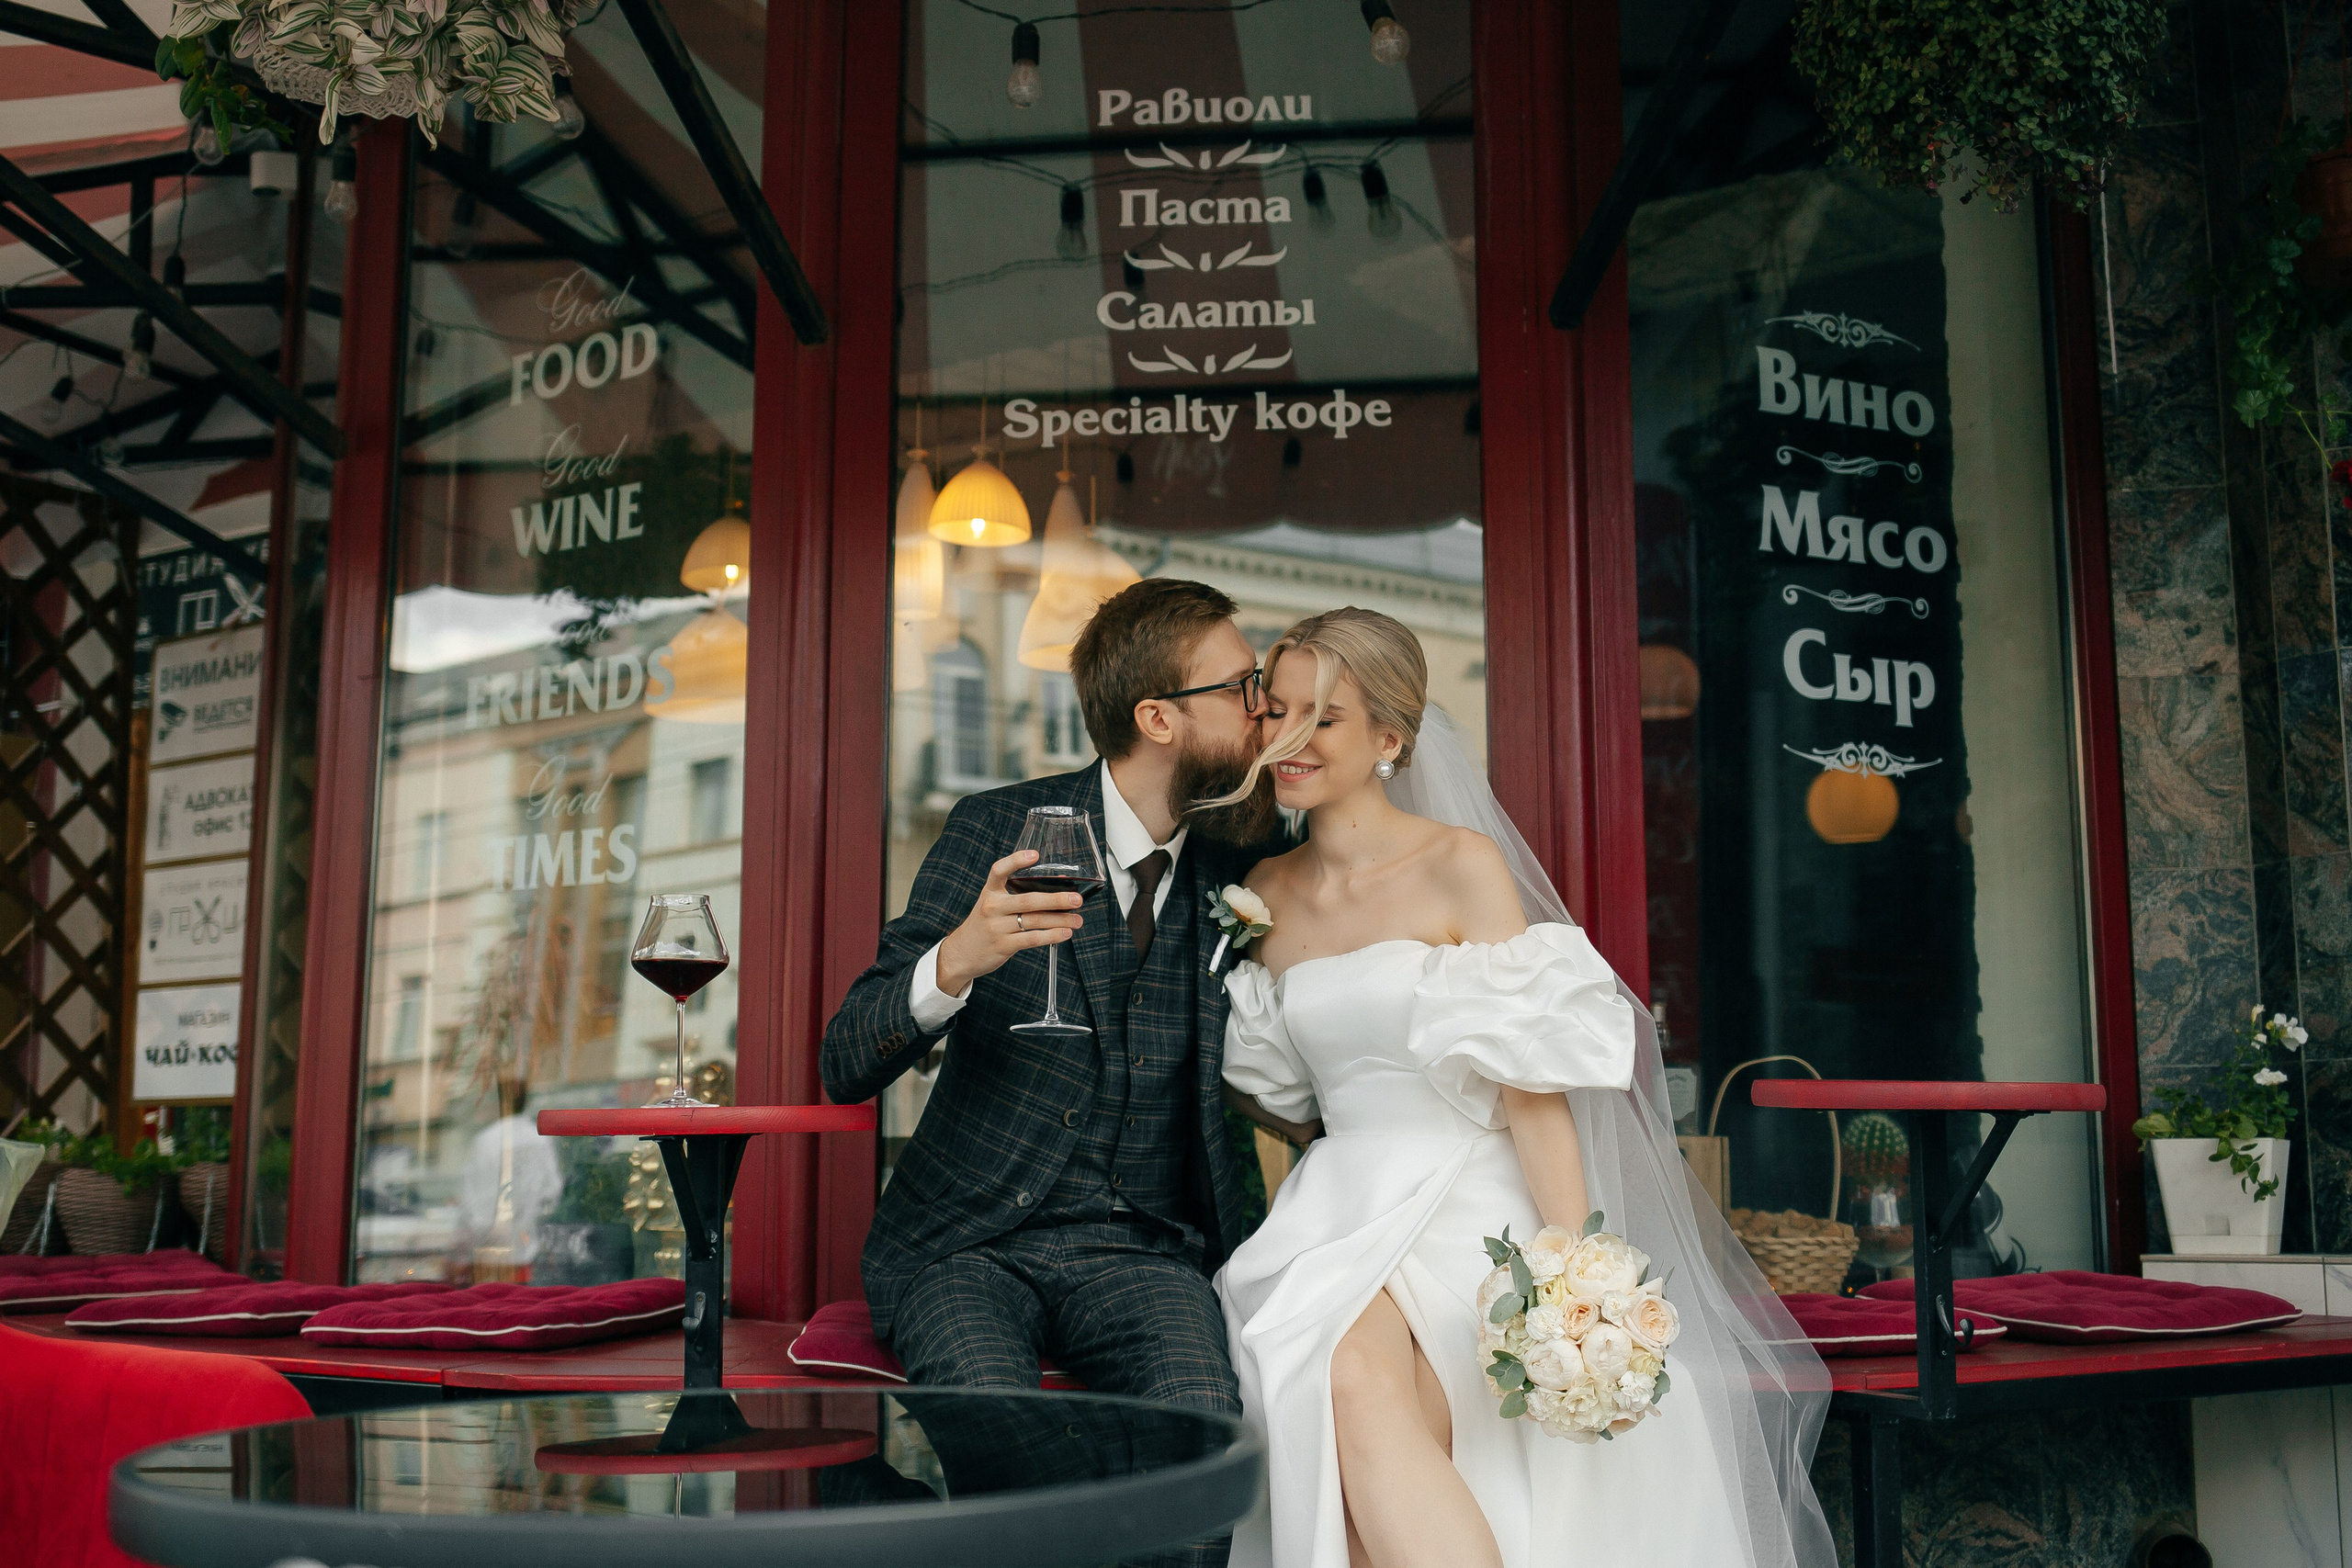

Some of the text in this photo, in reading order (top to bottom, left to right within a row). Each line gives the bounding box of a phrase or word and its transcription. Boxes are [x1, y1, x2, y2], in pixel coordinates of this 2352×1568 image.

[1097, 88, 1313, 126] Равиоли
[1119, 188, 1292, 226] Паста
[536, 266, 635, 333] Good
[1095, 291, 1316, 331] Салаты
[510, 322, 659, 406] FOOD
[1756, 345, 1935, 437] Вино
[1002, 389, 1393, 447] Specialty кофе
[533, 423, 629, 489] Good
[510, 480, 644, 558] WINE
[1758, 483, 1948, 573] Мясо
[464, 645, 676, 731] FRIENDS
[1783, 627, 1936, 728] Сыр
[183, 784, 253, 812] АДВОКА
[525, 755, 614, 821] Good
[486, 824, 638, 892] TIMES
